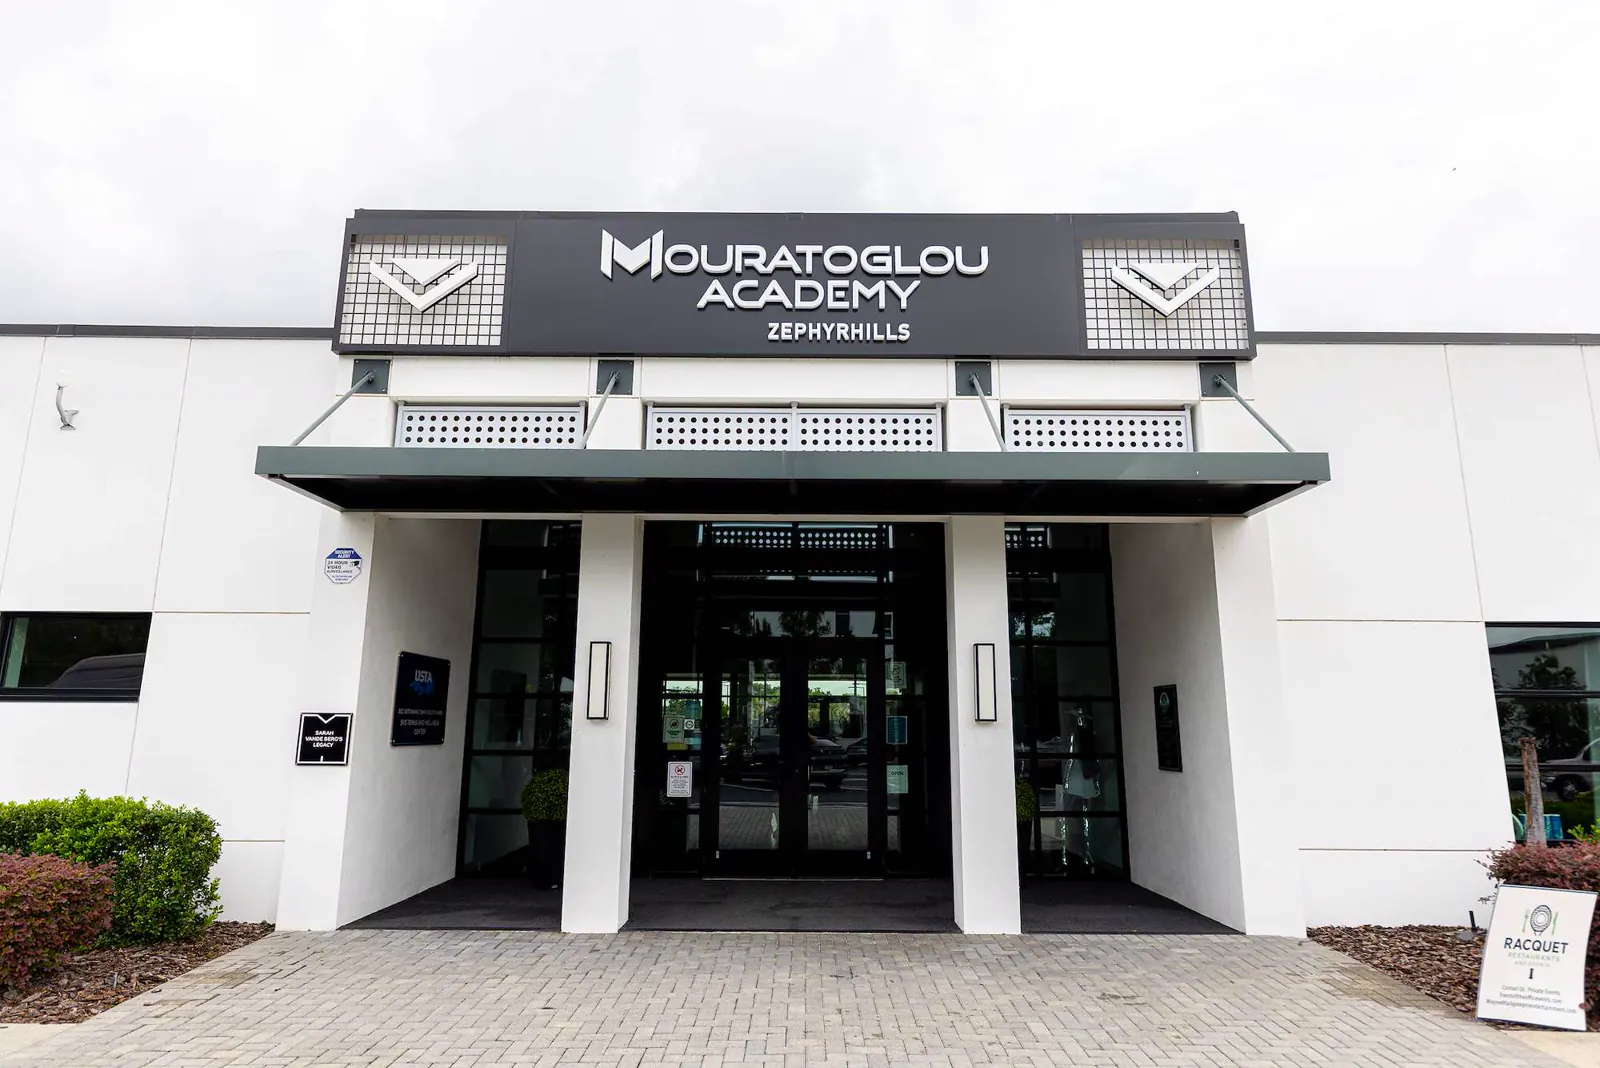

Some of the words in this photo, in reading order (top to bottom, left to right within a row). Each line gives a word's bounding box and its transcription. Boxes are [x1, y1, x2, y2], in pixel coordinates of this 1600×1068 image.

[600, 229, 989, 280] MOURATOGLOU
[696, 278, 921, 310] ACADEMY
[767, 322, 911, 342] ZEPHYRHILLS
[414, 669, 433, 683] USTA
[1503, 937, 1569, 954] RACQUET
[1508, 952, 1560, 962] RESTAURANTS
